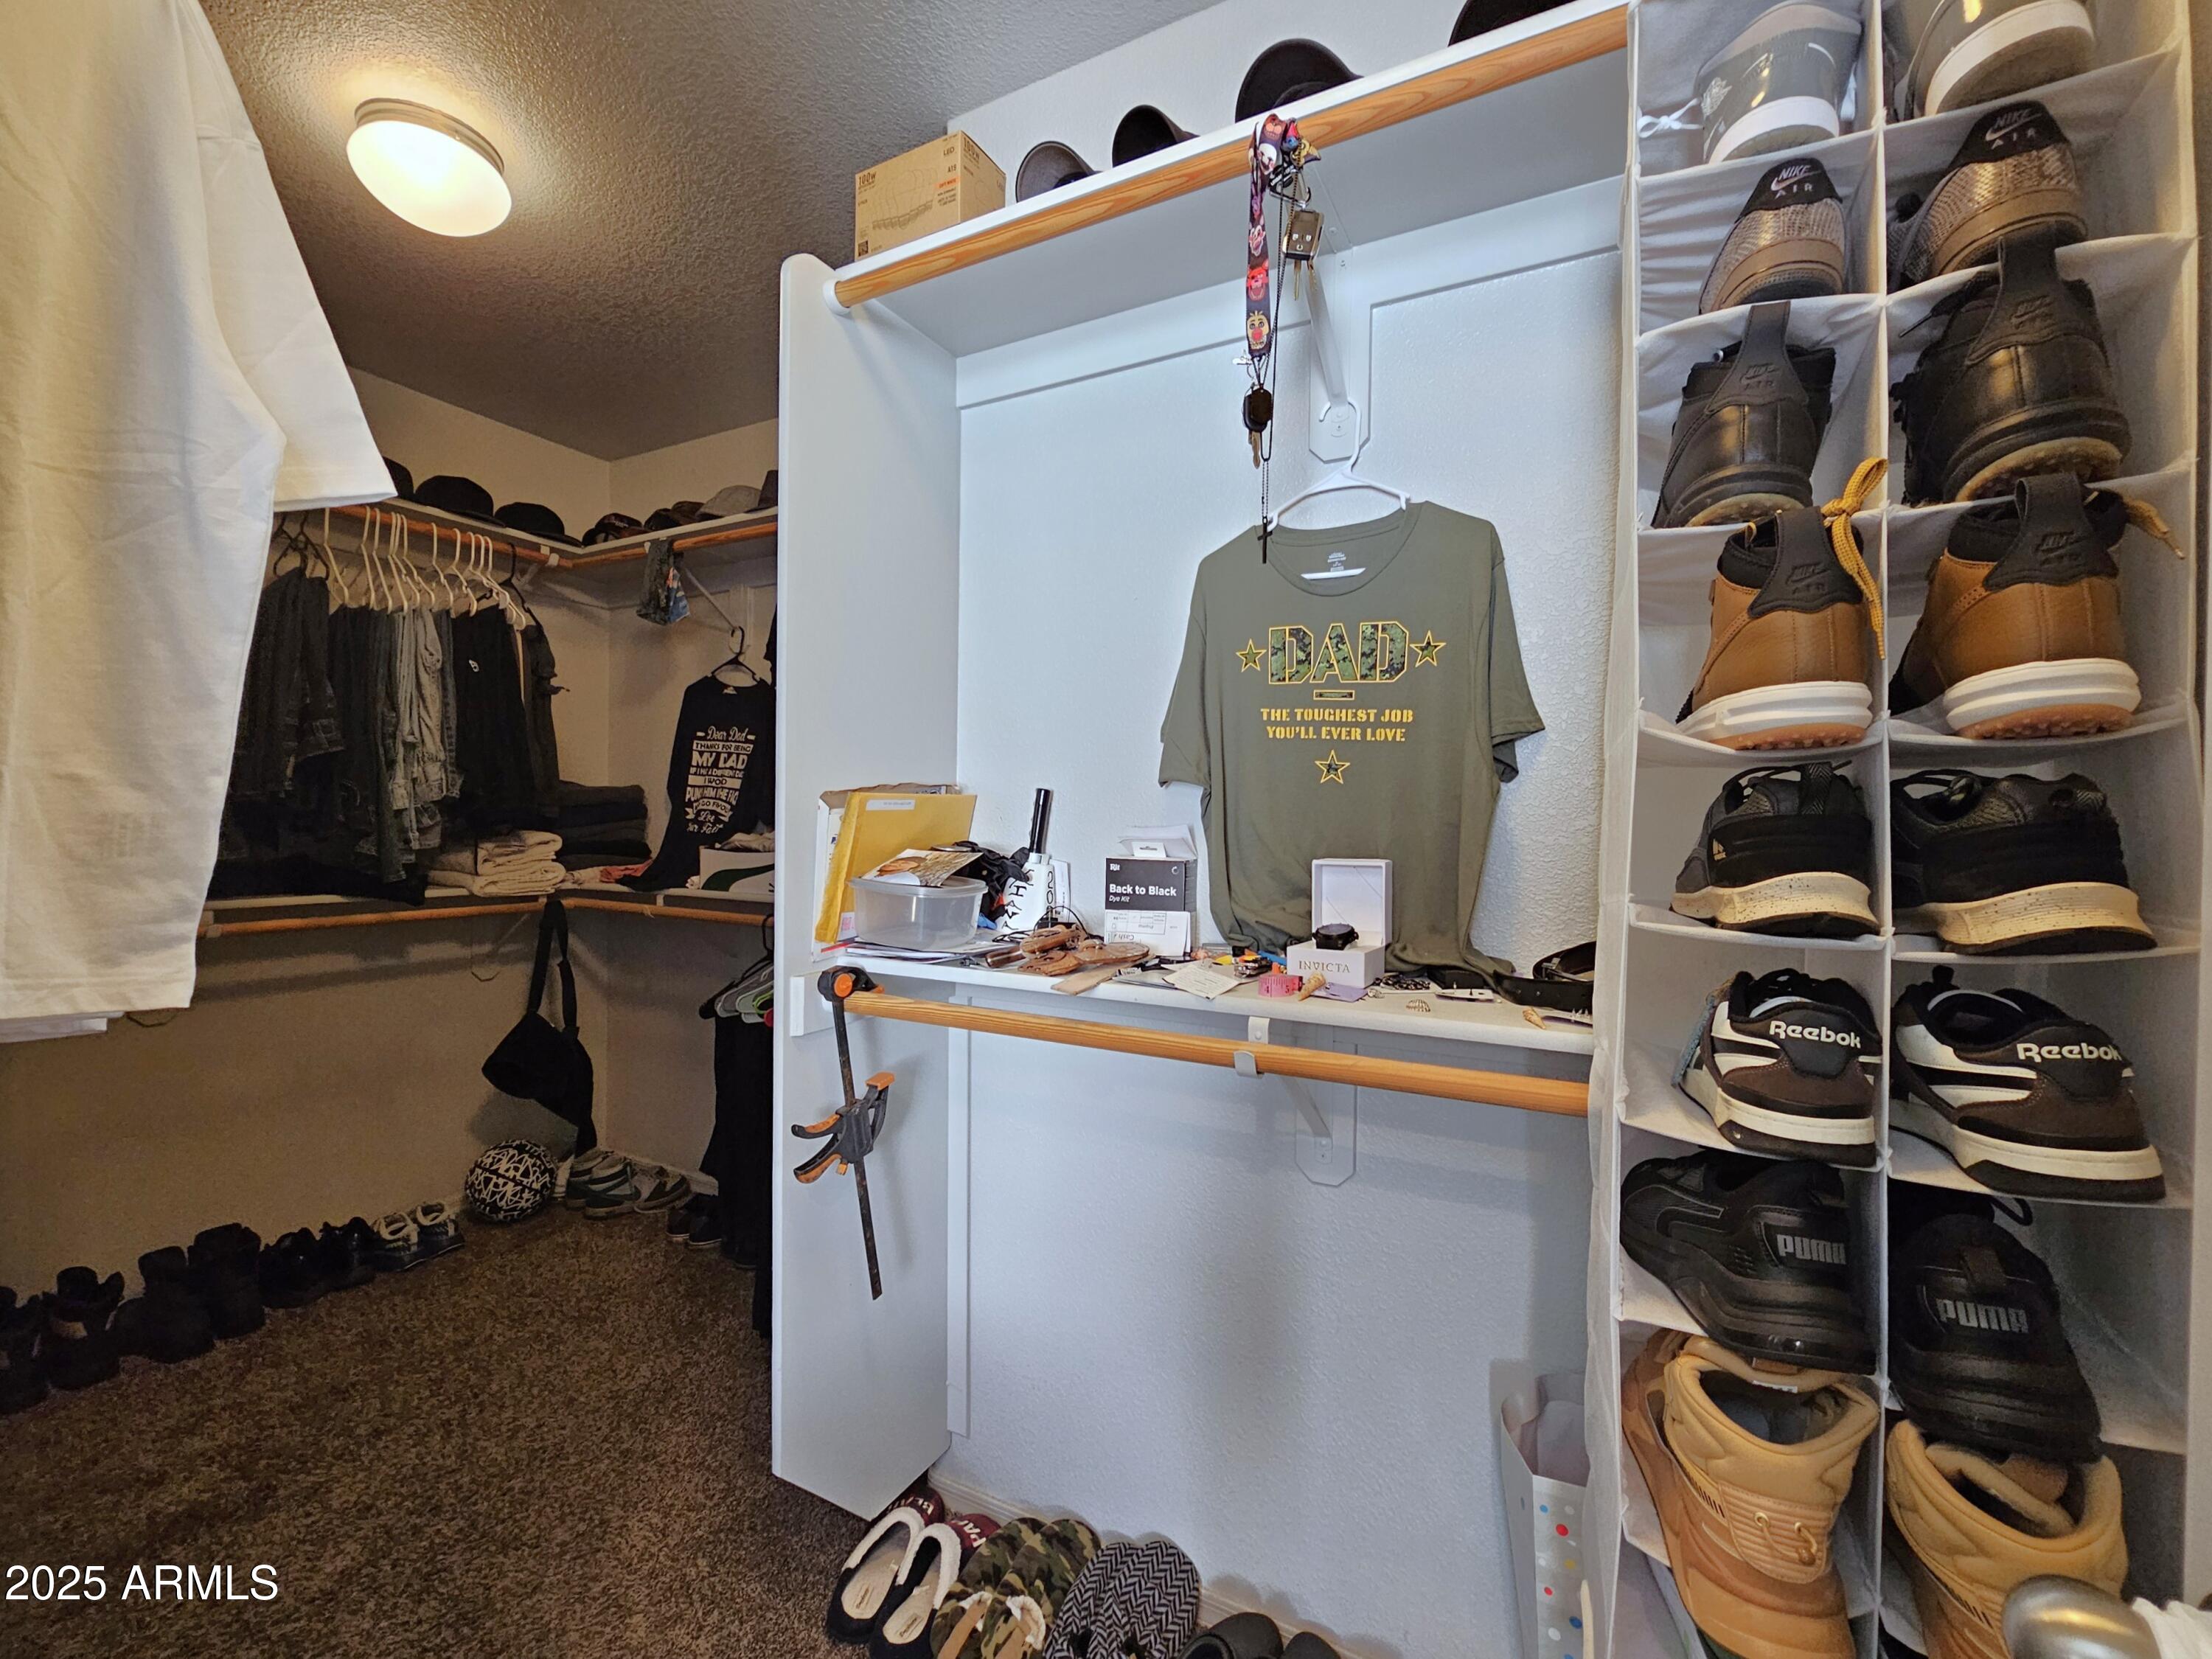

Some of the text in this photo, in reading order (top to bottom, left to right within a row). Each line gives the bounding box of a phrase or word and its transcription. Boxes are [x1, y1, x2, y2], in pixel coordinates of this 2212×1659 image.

[1993, 108, 2033, 129] NIKE
[1778, 164, 1812, 181] NIKE
[1774, 182, 1813, 200] AIR
[1268, 621, 1409, 685] DAD
[1260, 708, 1414, 723] THE TOUGHEST JOB
[706, 726, 748, 742] Dear Dad
[1321, 726, 1362, 741] EVER
[1366, 727, 1406, 742] LOVE
[695, 742, 720, 750] THANKS
[691, 751, 748, 770] MY DAD
[1109, 883, 1177, 897] Back to Black
[1298, 960, 1351, 973] INVICTA
[1769, 1020, 1862, 1049] Reebok
[2017, 1042, 2122, 1062] Reebok
[1777, 1234, 1846, 1265] PUMA
[1935, 1298, 2028, 1334] PUMA
